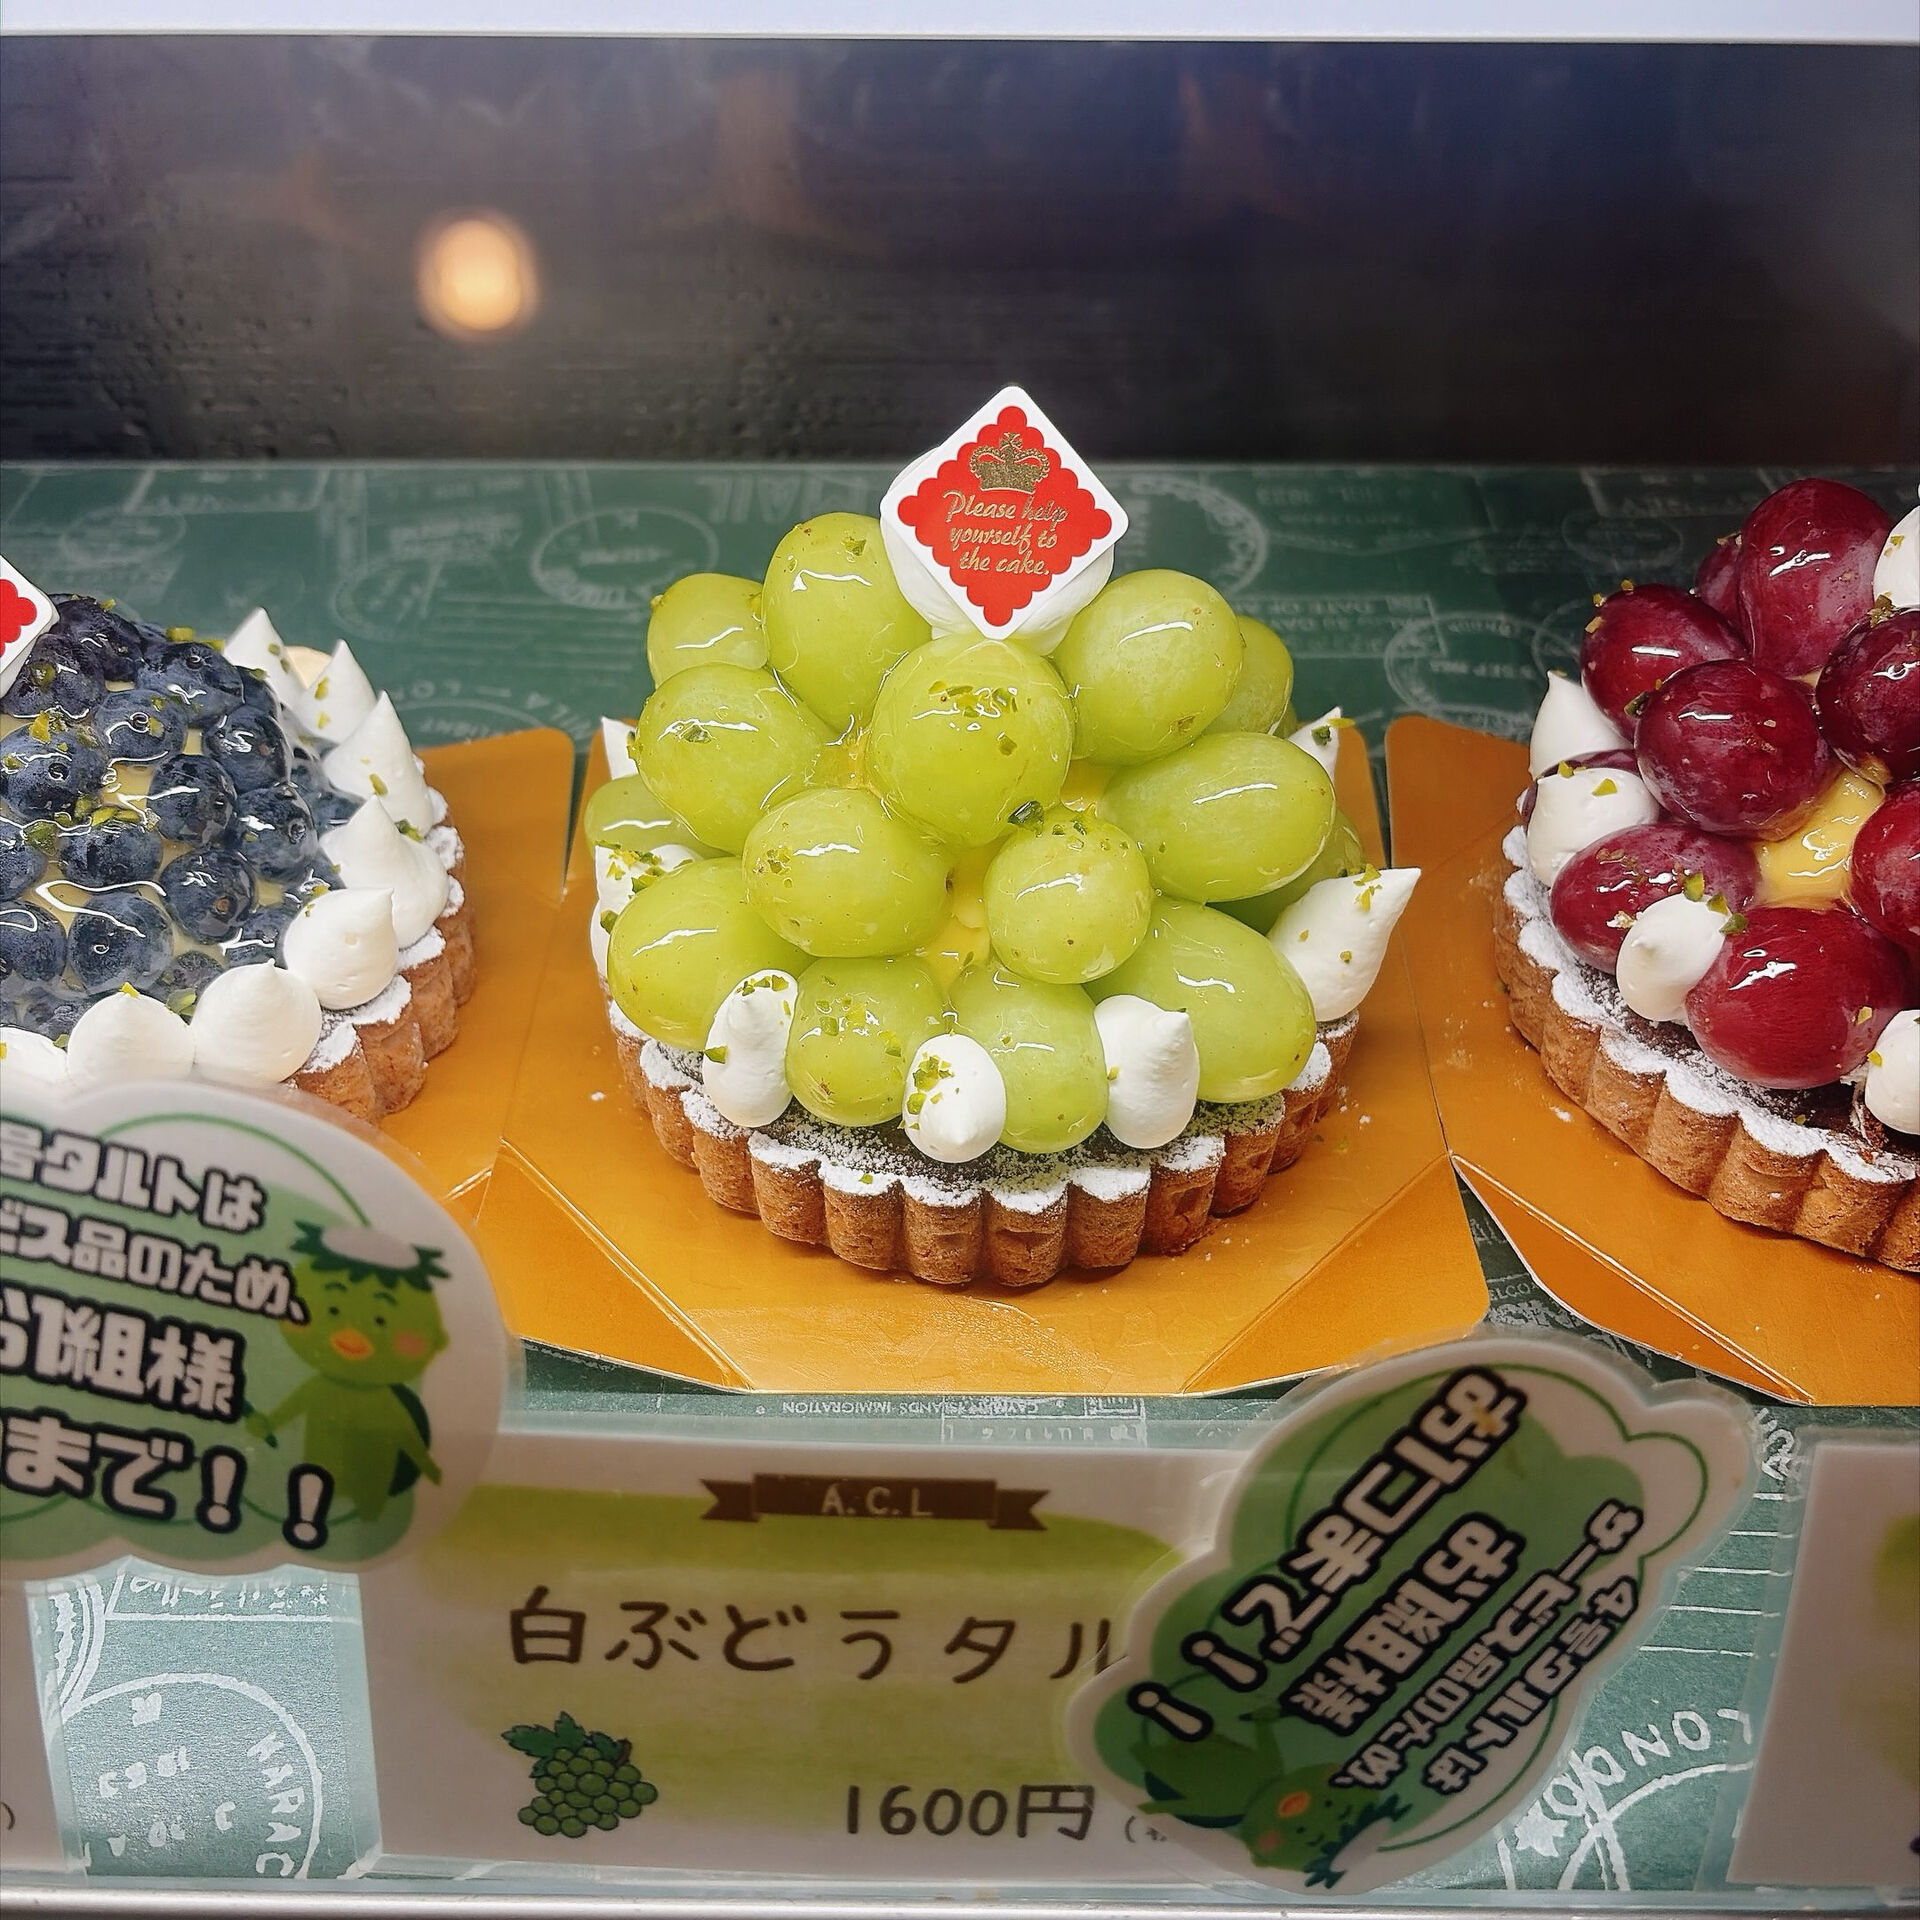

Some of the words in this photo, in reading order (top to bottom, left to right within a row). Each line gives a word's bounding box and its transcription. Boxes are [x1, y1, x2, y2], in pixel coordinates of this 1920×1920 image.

[943, 490, 1017, 522] Please
[1022, 495, 1069, 533] help
[949, 523, 1031, 555] yourself
[1037, 529, 1058, 549] to
[959, 547, 990, 571] the
[995, 551, 1050, 576] cake.
[782, 1401, 892, 1414] IMMIGRATION
[844, 1784, 1096, 1841] 1600円
